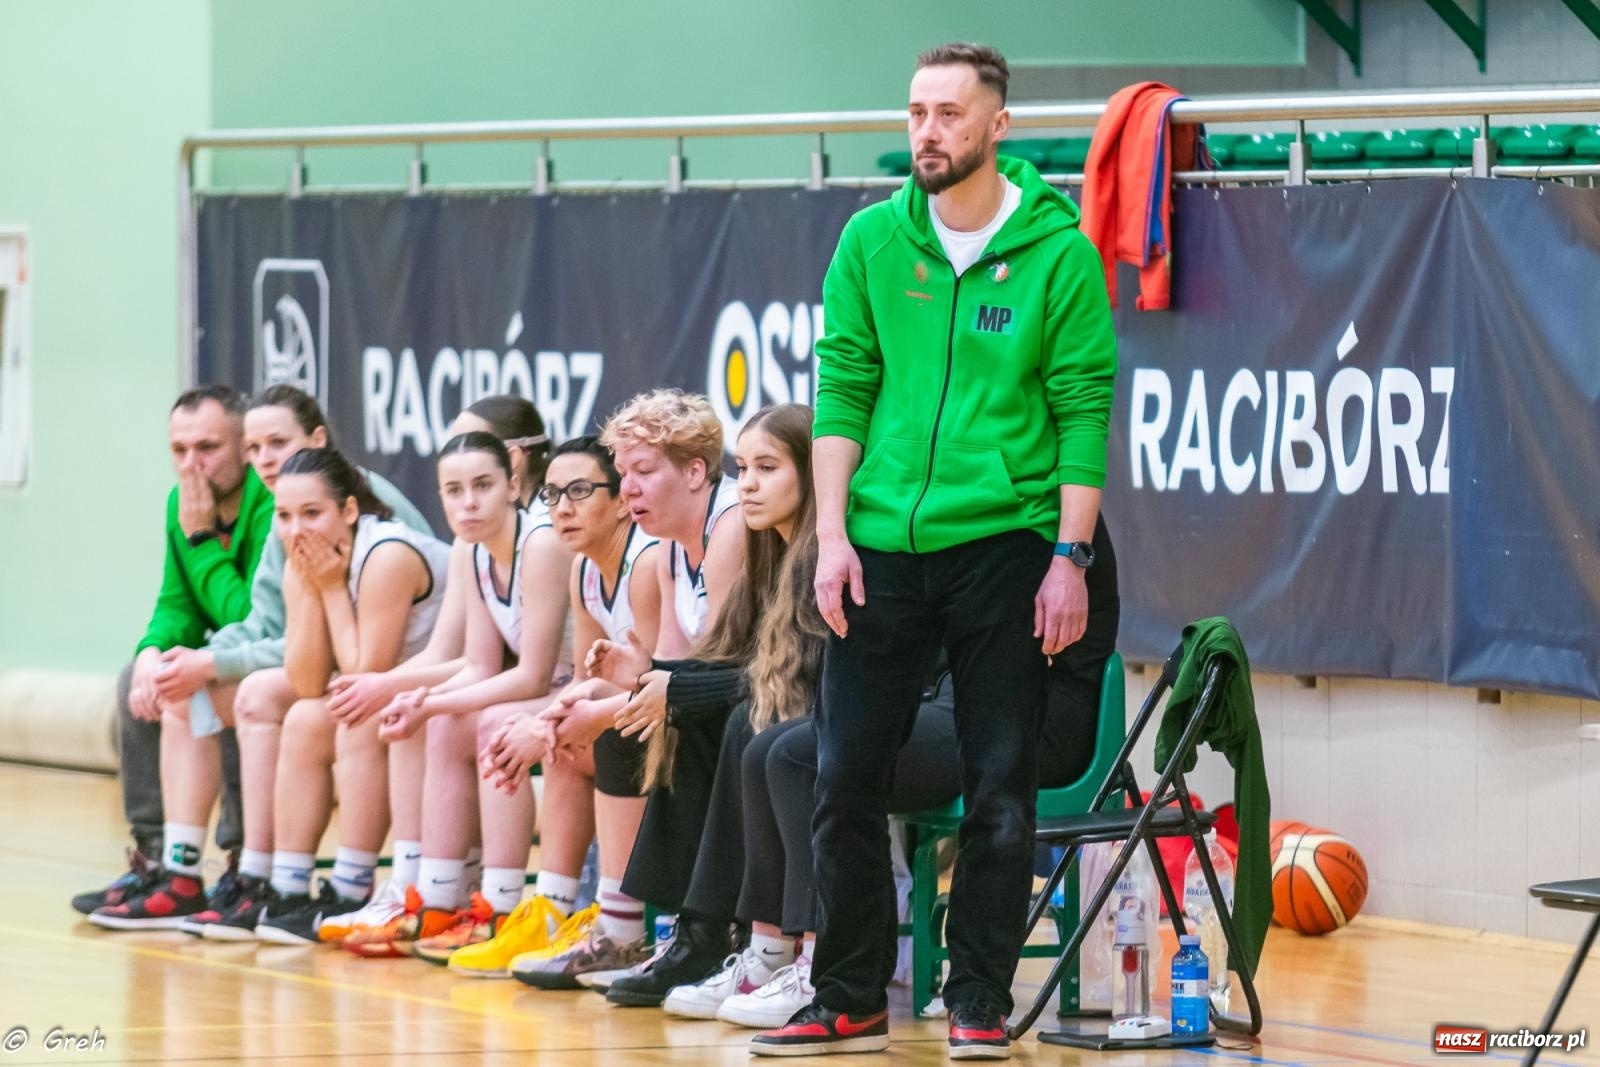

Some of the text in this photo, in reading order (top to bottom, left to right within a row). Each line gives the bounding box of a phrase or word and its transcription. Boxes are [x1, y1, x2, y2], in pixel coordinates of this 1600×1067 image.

[707, 301, 824, 456] OSi
[976, 304, 1012, 333] MP
[1130, 320, 1455, 495] RACIBÓRZ
